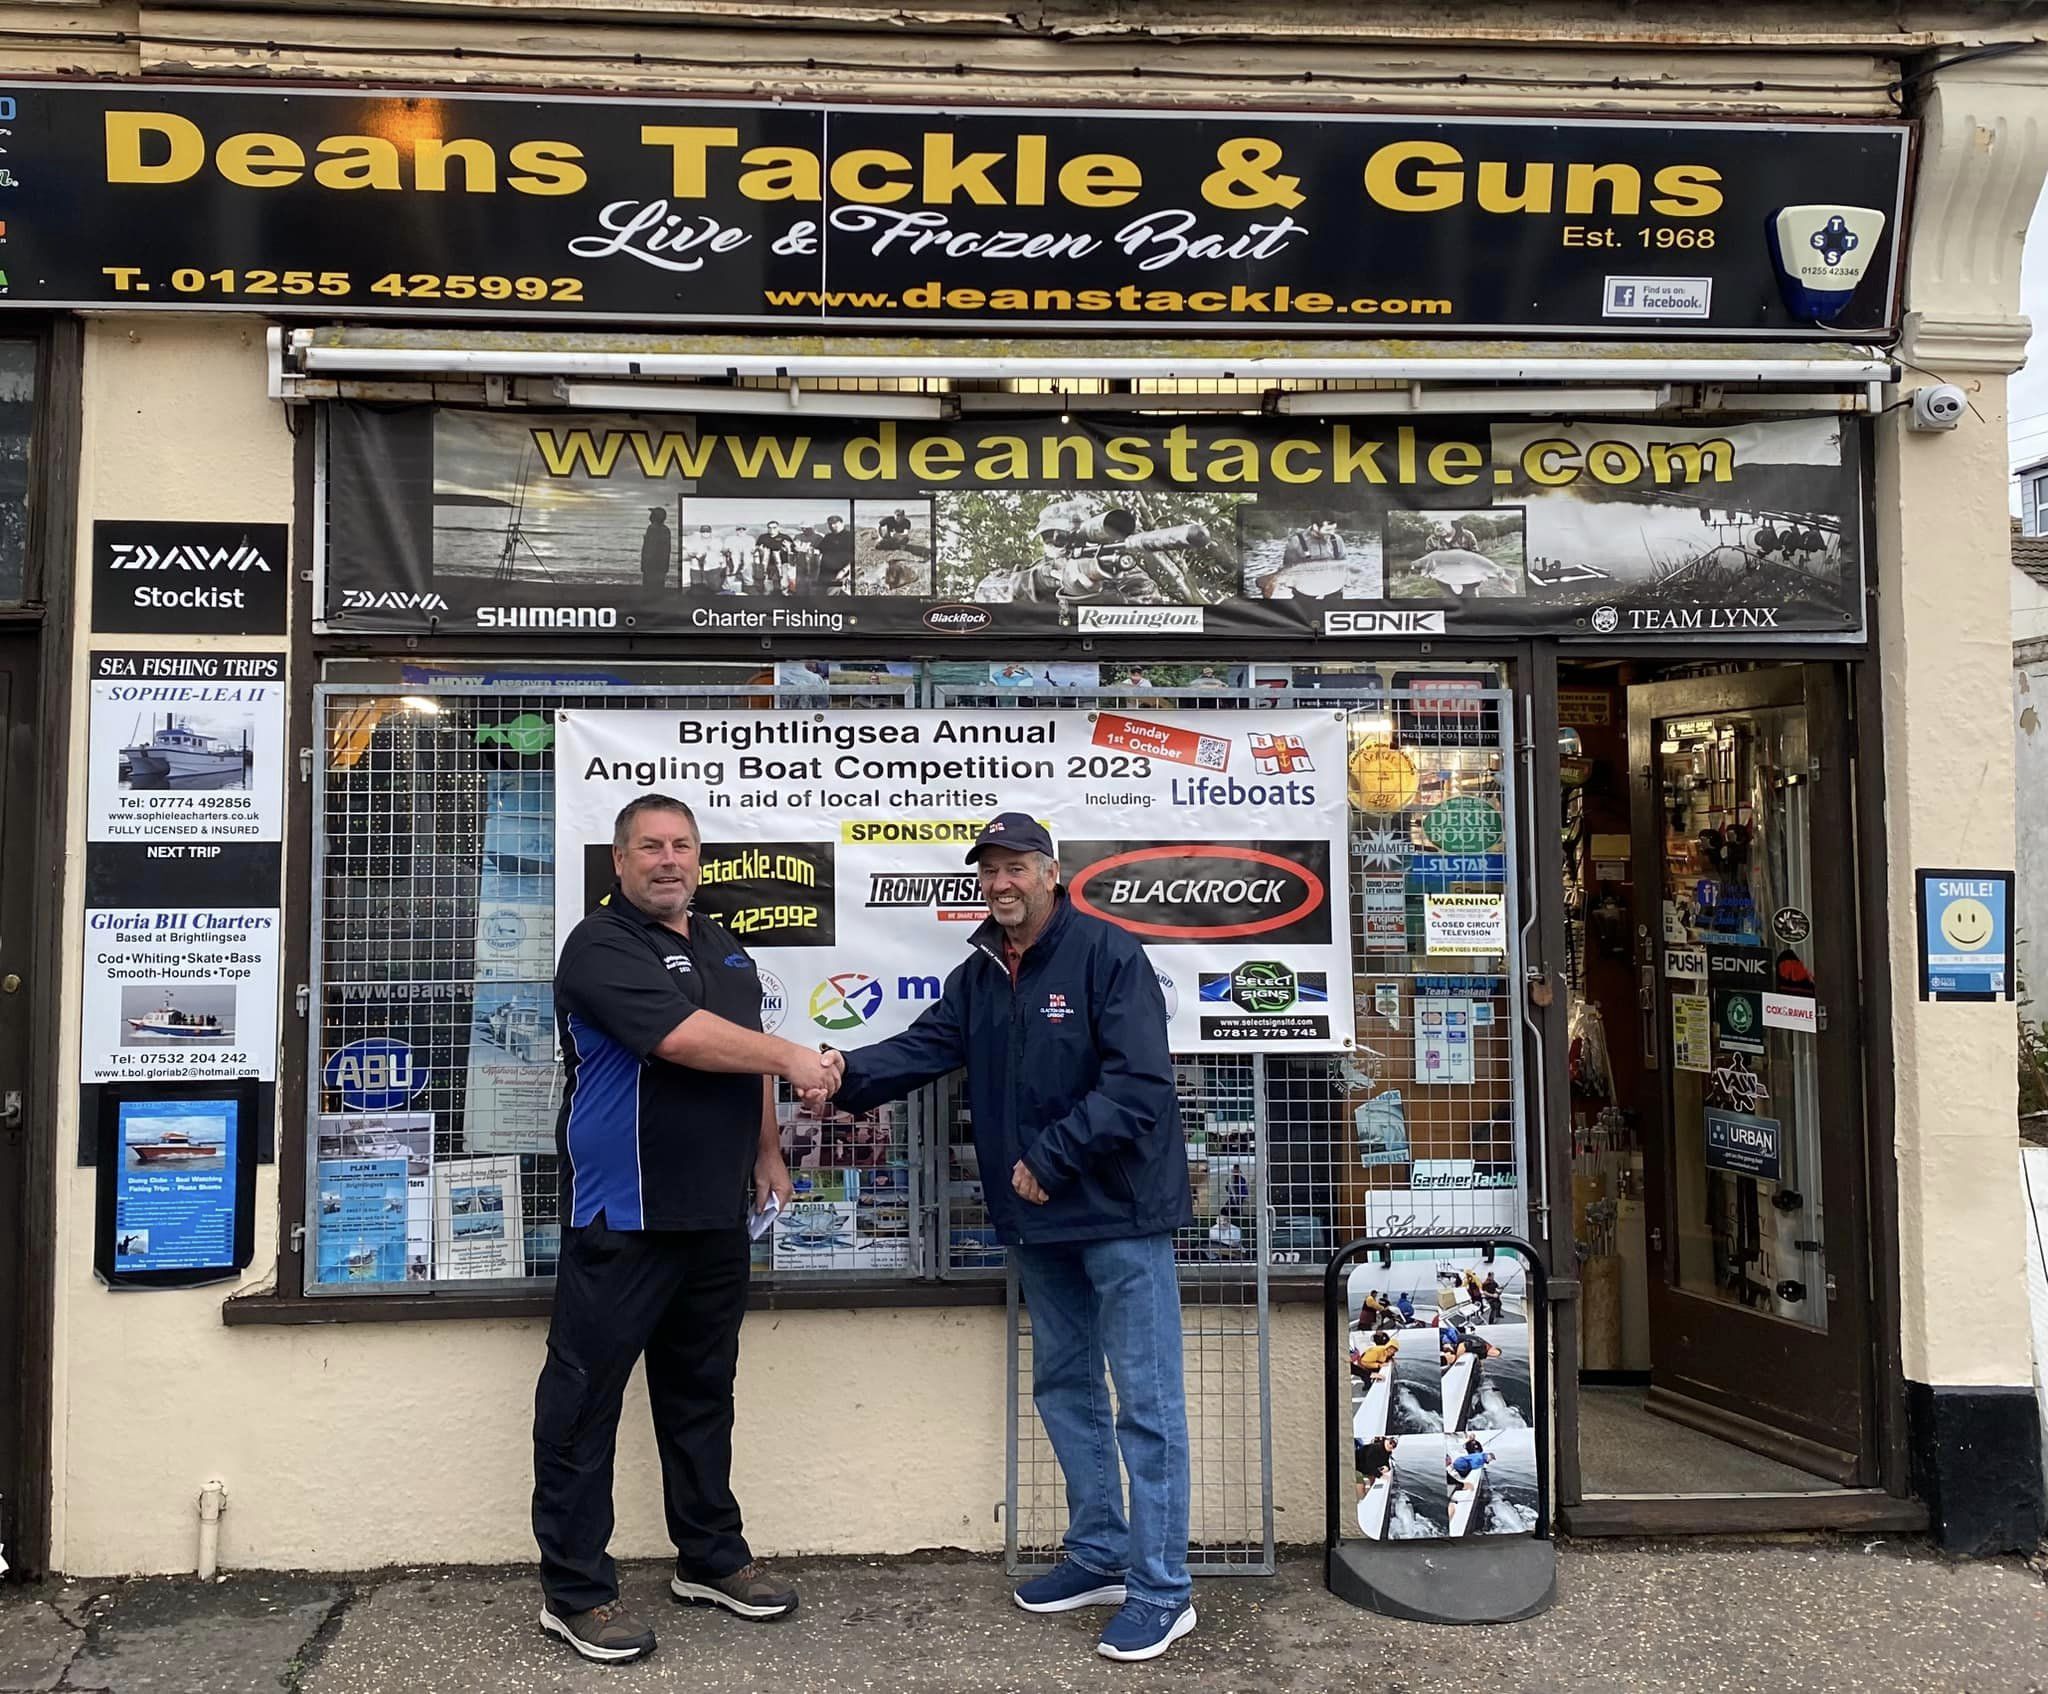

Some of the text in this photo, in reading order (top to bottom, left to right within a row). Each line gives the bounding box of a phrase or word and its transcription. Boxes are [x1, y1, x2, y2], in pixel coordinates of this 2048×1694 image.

[105, 110, 1724, 217] Deans Tackle & Guns
[568, 199, 1309, 272] Live & Frozen Bait
[1562, 226, 1716, 249] Est. 1968
[1802, 267, 1860, 276] 01255 423345
[103, 268, 584, 302] T. 01255 425992
[1643, 286, 1661, 295] Find
[1662, 287, 1672, 295] us
[764, 281, 1453, 318] www.deanstackle.com
[528, 421, 1736, 487] www.deanstackle.com
[134, 586, 245, 610] Stockist
[476, 606, 617, 628] SHIMANO
[691, 608, 843, 633] Charter Fishing
[929, 611, 987, 625] BlackRock
[1080, 608, 1201, 630] Remington
[1328, 613, 1443, 632] SONIK
[1628, 607, 1780, 629] TEAM LYNX
[99, 658, 278, 677] SEA FISHING TRIPS
[108, 686, 266, 703] SOPHIE-LEA II
[680, 720, 1056, 750] Brightlingsea Annual
[1123, 721, 1171, 744] Sunday
[1107, 733, 1183, 759] 1st October
[585, 755, 1152, 786] Angling Boat Competition 2023
[709, 788, 998, 808] in aid of local charities
[1172, 776, 1316, 807] Lifeboats
[119, 797, 251, 809] Tel: 07774 492856
[108, 811, 260, 822] www.sophieleacharters.co.uk
[108, 825, 260, 836] FULLY LICENSED & INSURED
[851, 823, 985, 841] SPONSORE
[1430, 826, 1498, 843] BOOTS
[147, 846, 221, 859] NEXT TRIP
[1353, 843, 1415, 854] DYNAMITE
[1110, 879, 1287, 906] BLACKROCK
[1938, 882, 1993, 897] SMILE!
[1431, 897, 1499, 906] WARNING
[90, 912, 151, 932] Gloria
[191, 912, 273, 931] Charters
[730, 906, 818, 935] 425992
[1466, 921, 1501, 929] CIRCUIT
[115, 931, 247, 945] Based at Brightlingsea
[1441, 929, 1492, 937] TELEVISION
[1667, 952, 1704, 973] PUSH
[1711, 956, 1769, 975] SONIK
[1234, 974, 1293, 986] SELECT
[1241, 989, 1291, 1000] SIGNS
[1213, 1028, 1318, 1038] 07812 779 745
[110, 1053, 247, 1064] Tel: 07532 204 242
[337, 1053, 413, 1089] ABU
[1729, 1127, 1773, 1151] URBAN
[1413, 1172, 1472, 1188] Gardner
